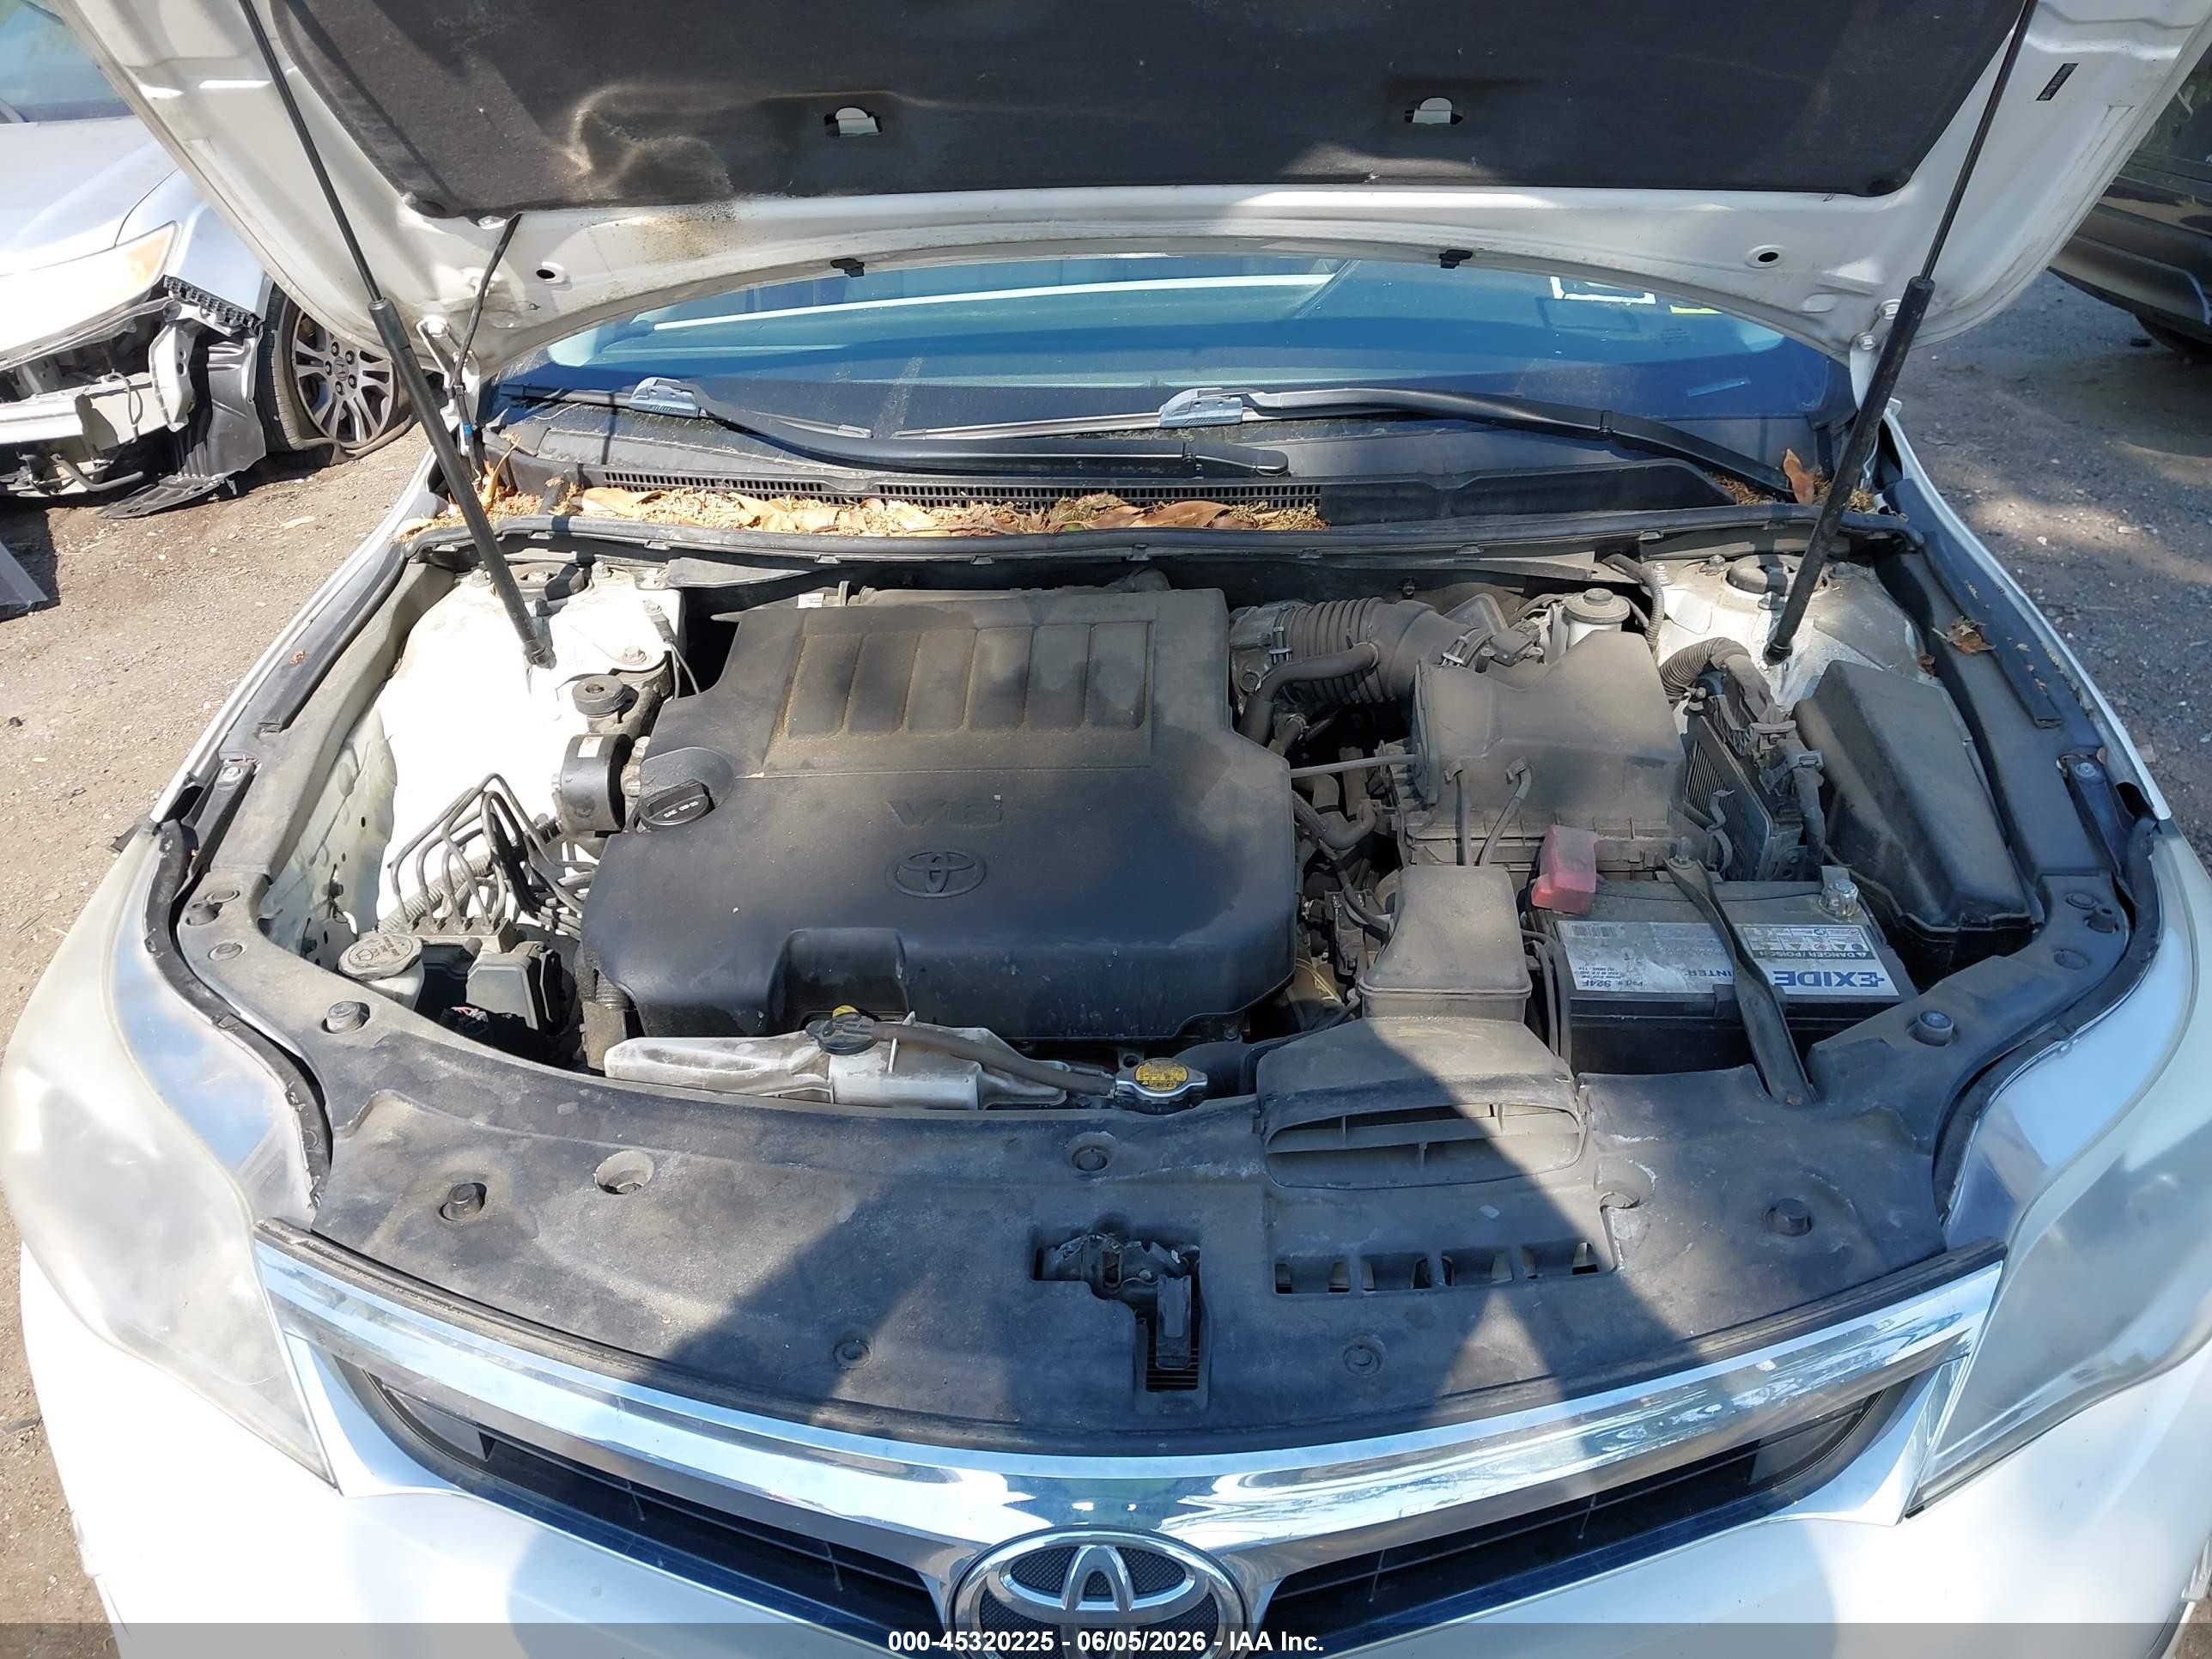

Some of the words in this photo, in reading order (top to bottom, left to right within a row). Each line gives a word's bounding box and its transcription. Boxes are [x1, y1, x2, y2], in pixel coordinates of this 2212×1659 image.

[886, 796, 1003, 827] V6
[1682, 969, 1732, 977] INTER
[1773, 970, 1885, 988] EXIDE
